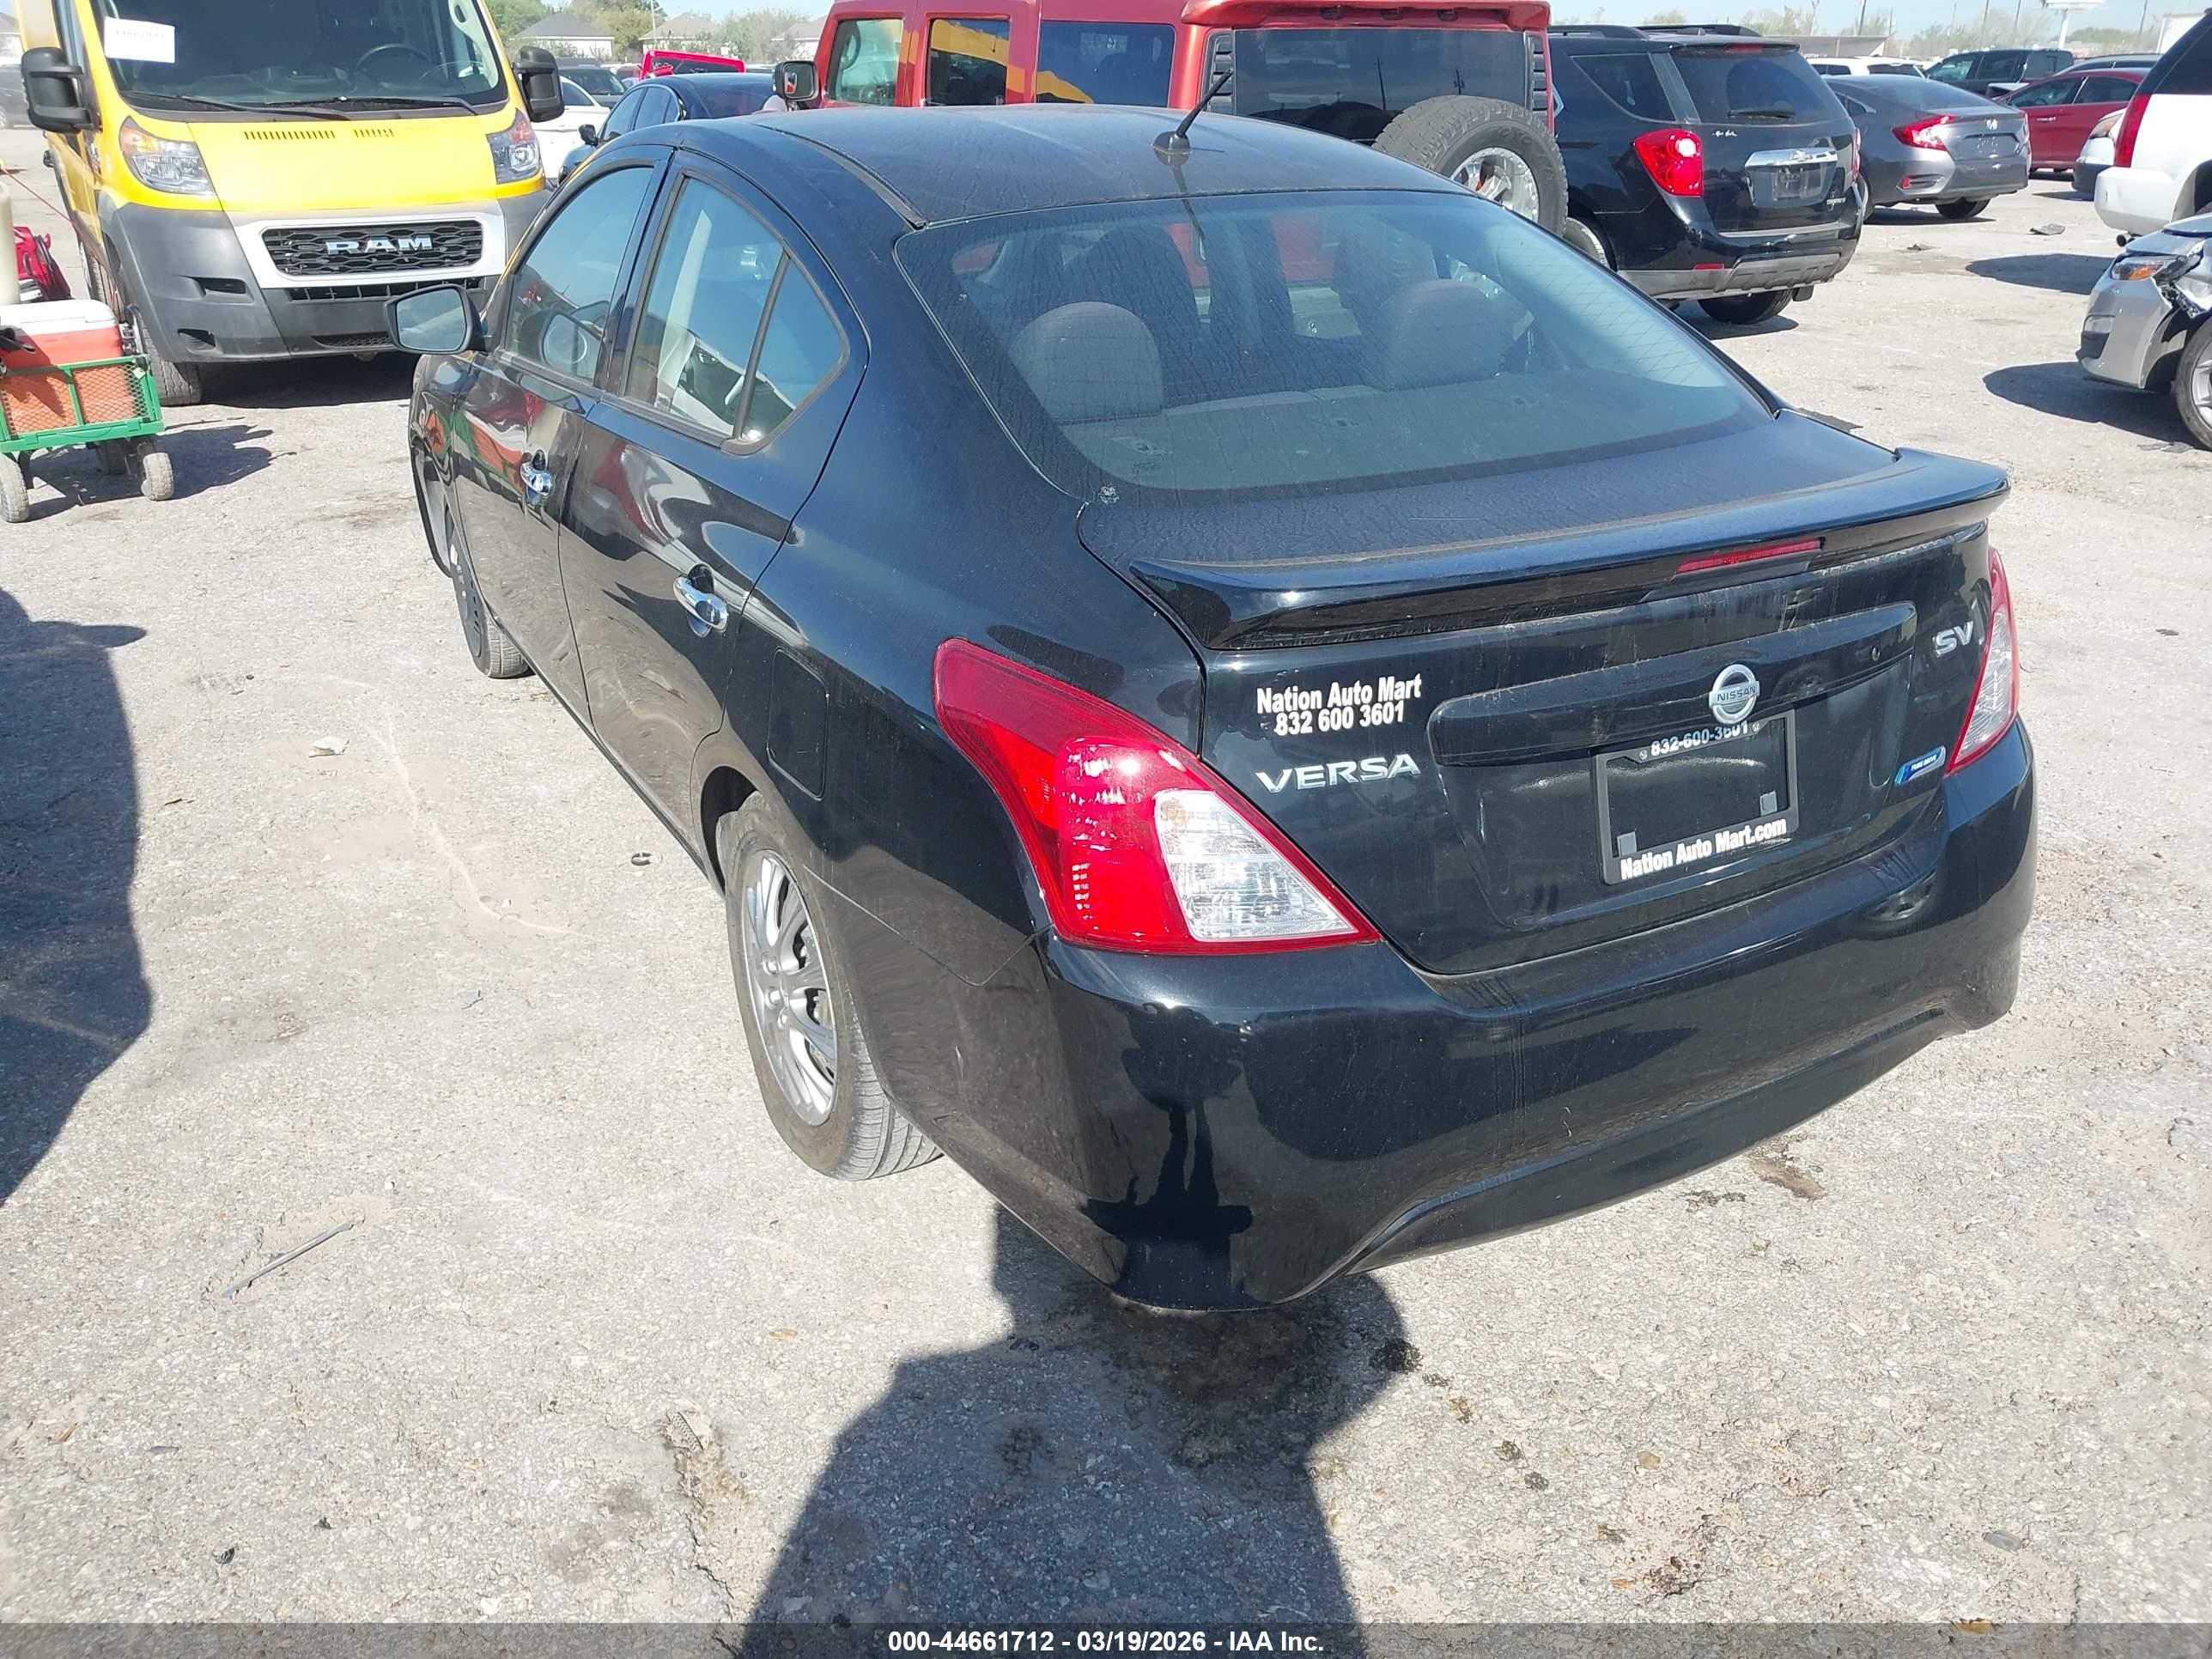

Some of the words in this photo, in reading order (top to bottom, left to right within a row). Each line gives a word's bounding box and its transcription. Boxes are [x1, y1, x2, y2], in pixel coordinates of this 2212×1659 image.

[326, 234, 433, 255] RAM
[1933, 621, 1973, 656] SV
[1257, 685, 1322, 714] Nation
[1328, 679, 1373, 708] Auto
[1378, 673, 1422, 702] Mart
[1717, 686, 1756, 702] NISSAN
[1274, 710, 1313, 736] 832
[1318, 706, 1354, 731] 600
[1359, 700, 1404, 727] 3601
[1255, 753, 1422, 793] VERSA
[1620, 849, 1674, 880] Nation
[1675, 838, 1713, 865] Auto
[1715, 817, 1787, 854] Mart.com
